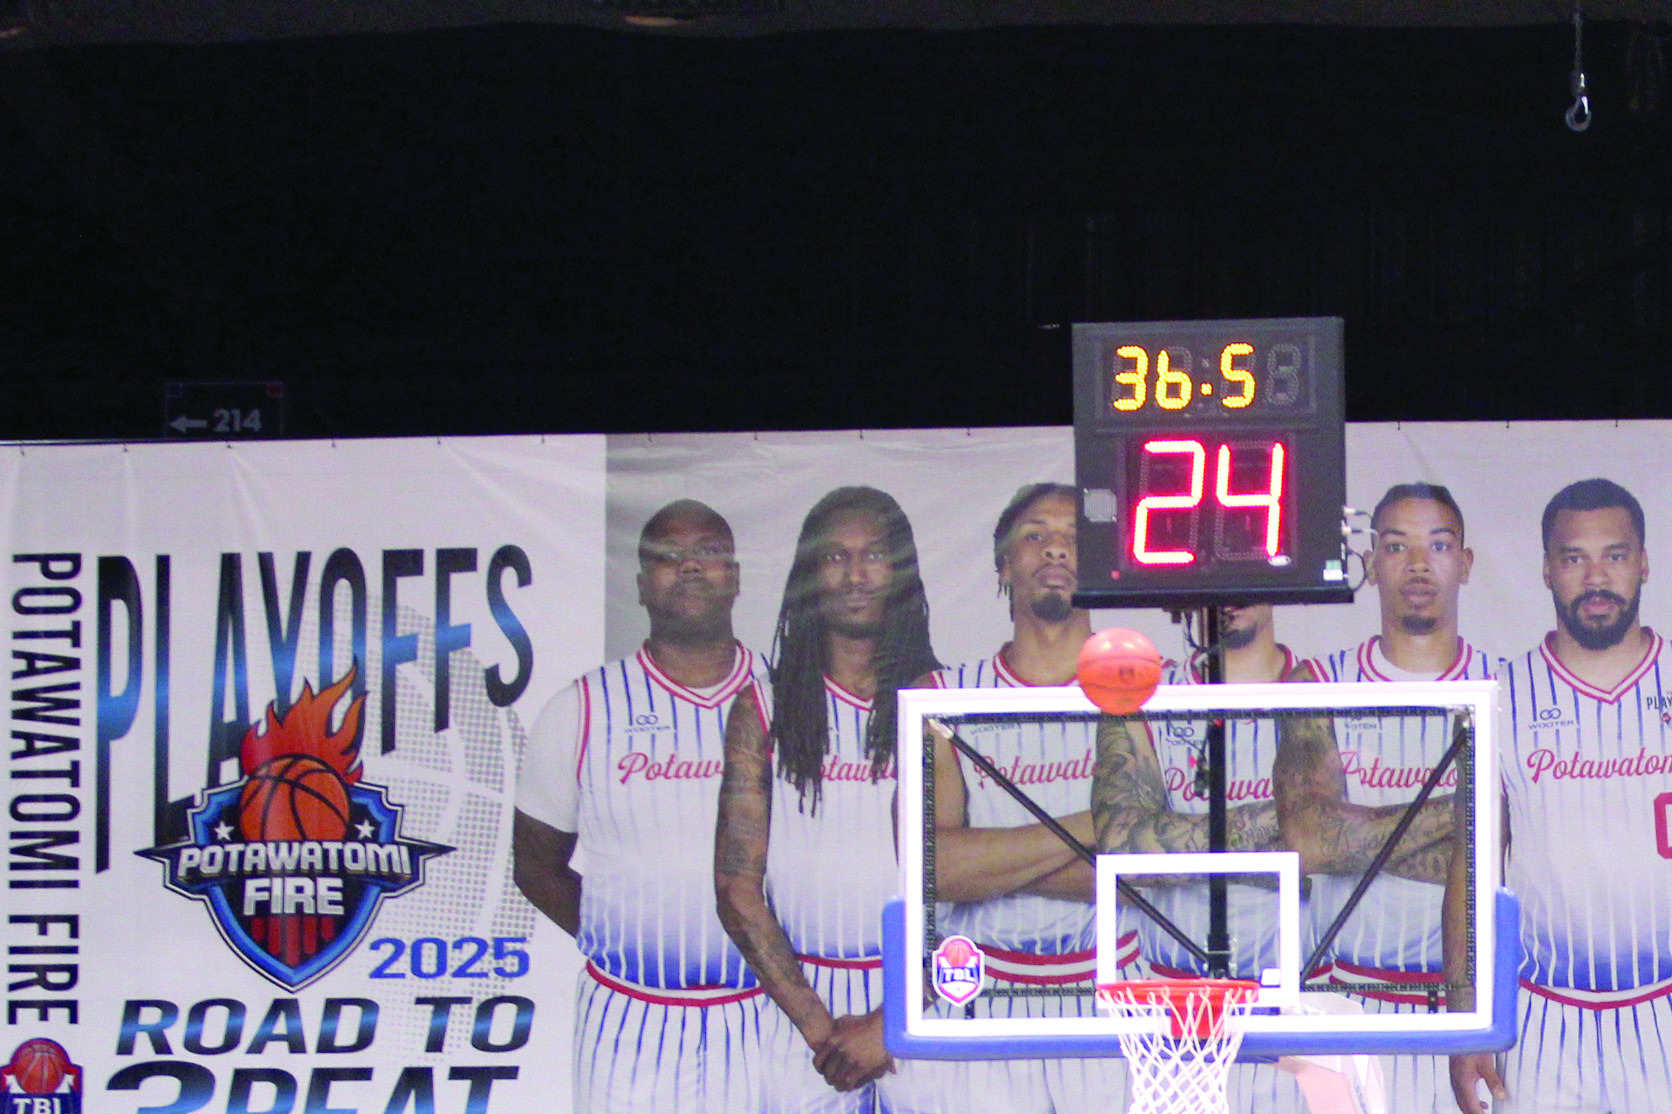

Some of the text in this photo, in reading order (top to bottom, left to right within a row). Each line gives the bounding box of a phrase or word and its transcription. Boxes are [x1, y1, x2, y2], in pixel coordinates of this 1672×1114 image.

[212, 407, 263, 433] 214
[1132, 438, 1286, 565] 24
[96, 544, 534, 874] PLAYOFFS
[1528, 719, 1575, 730] WOOTER
[7, 552, 82, 1025] POTAWATOMI FIRE
[177, 840, 412, 877] POTAWATOMI
[243, 876, 345, 916] FIRE
[367, 937, 531, 980] 2025
[943, 968, 975, 983] TBL
[115, 993, 536, 1056] ROAD TO
